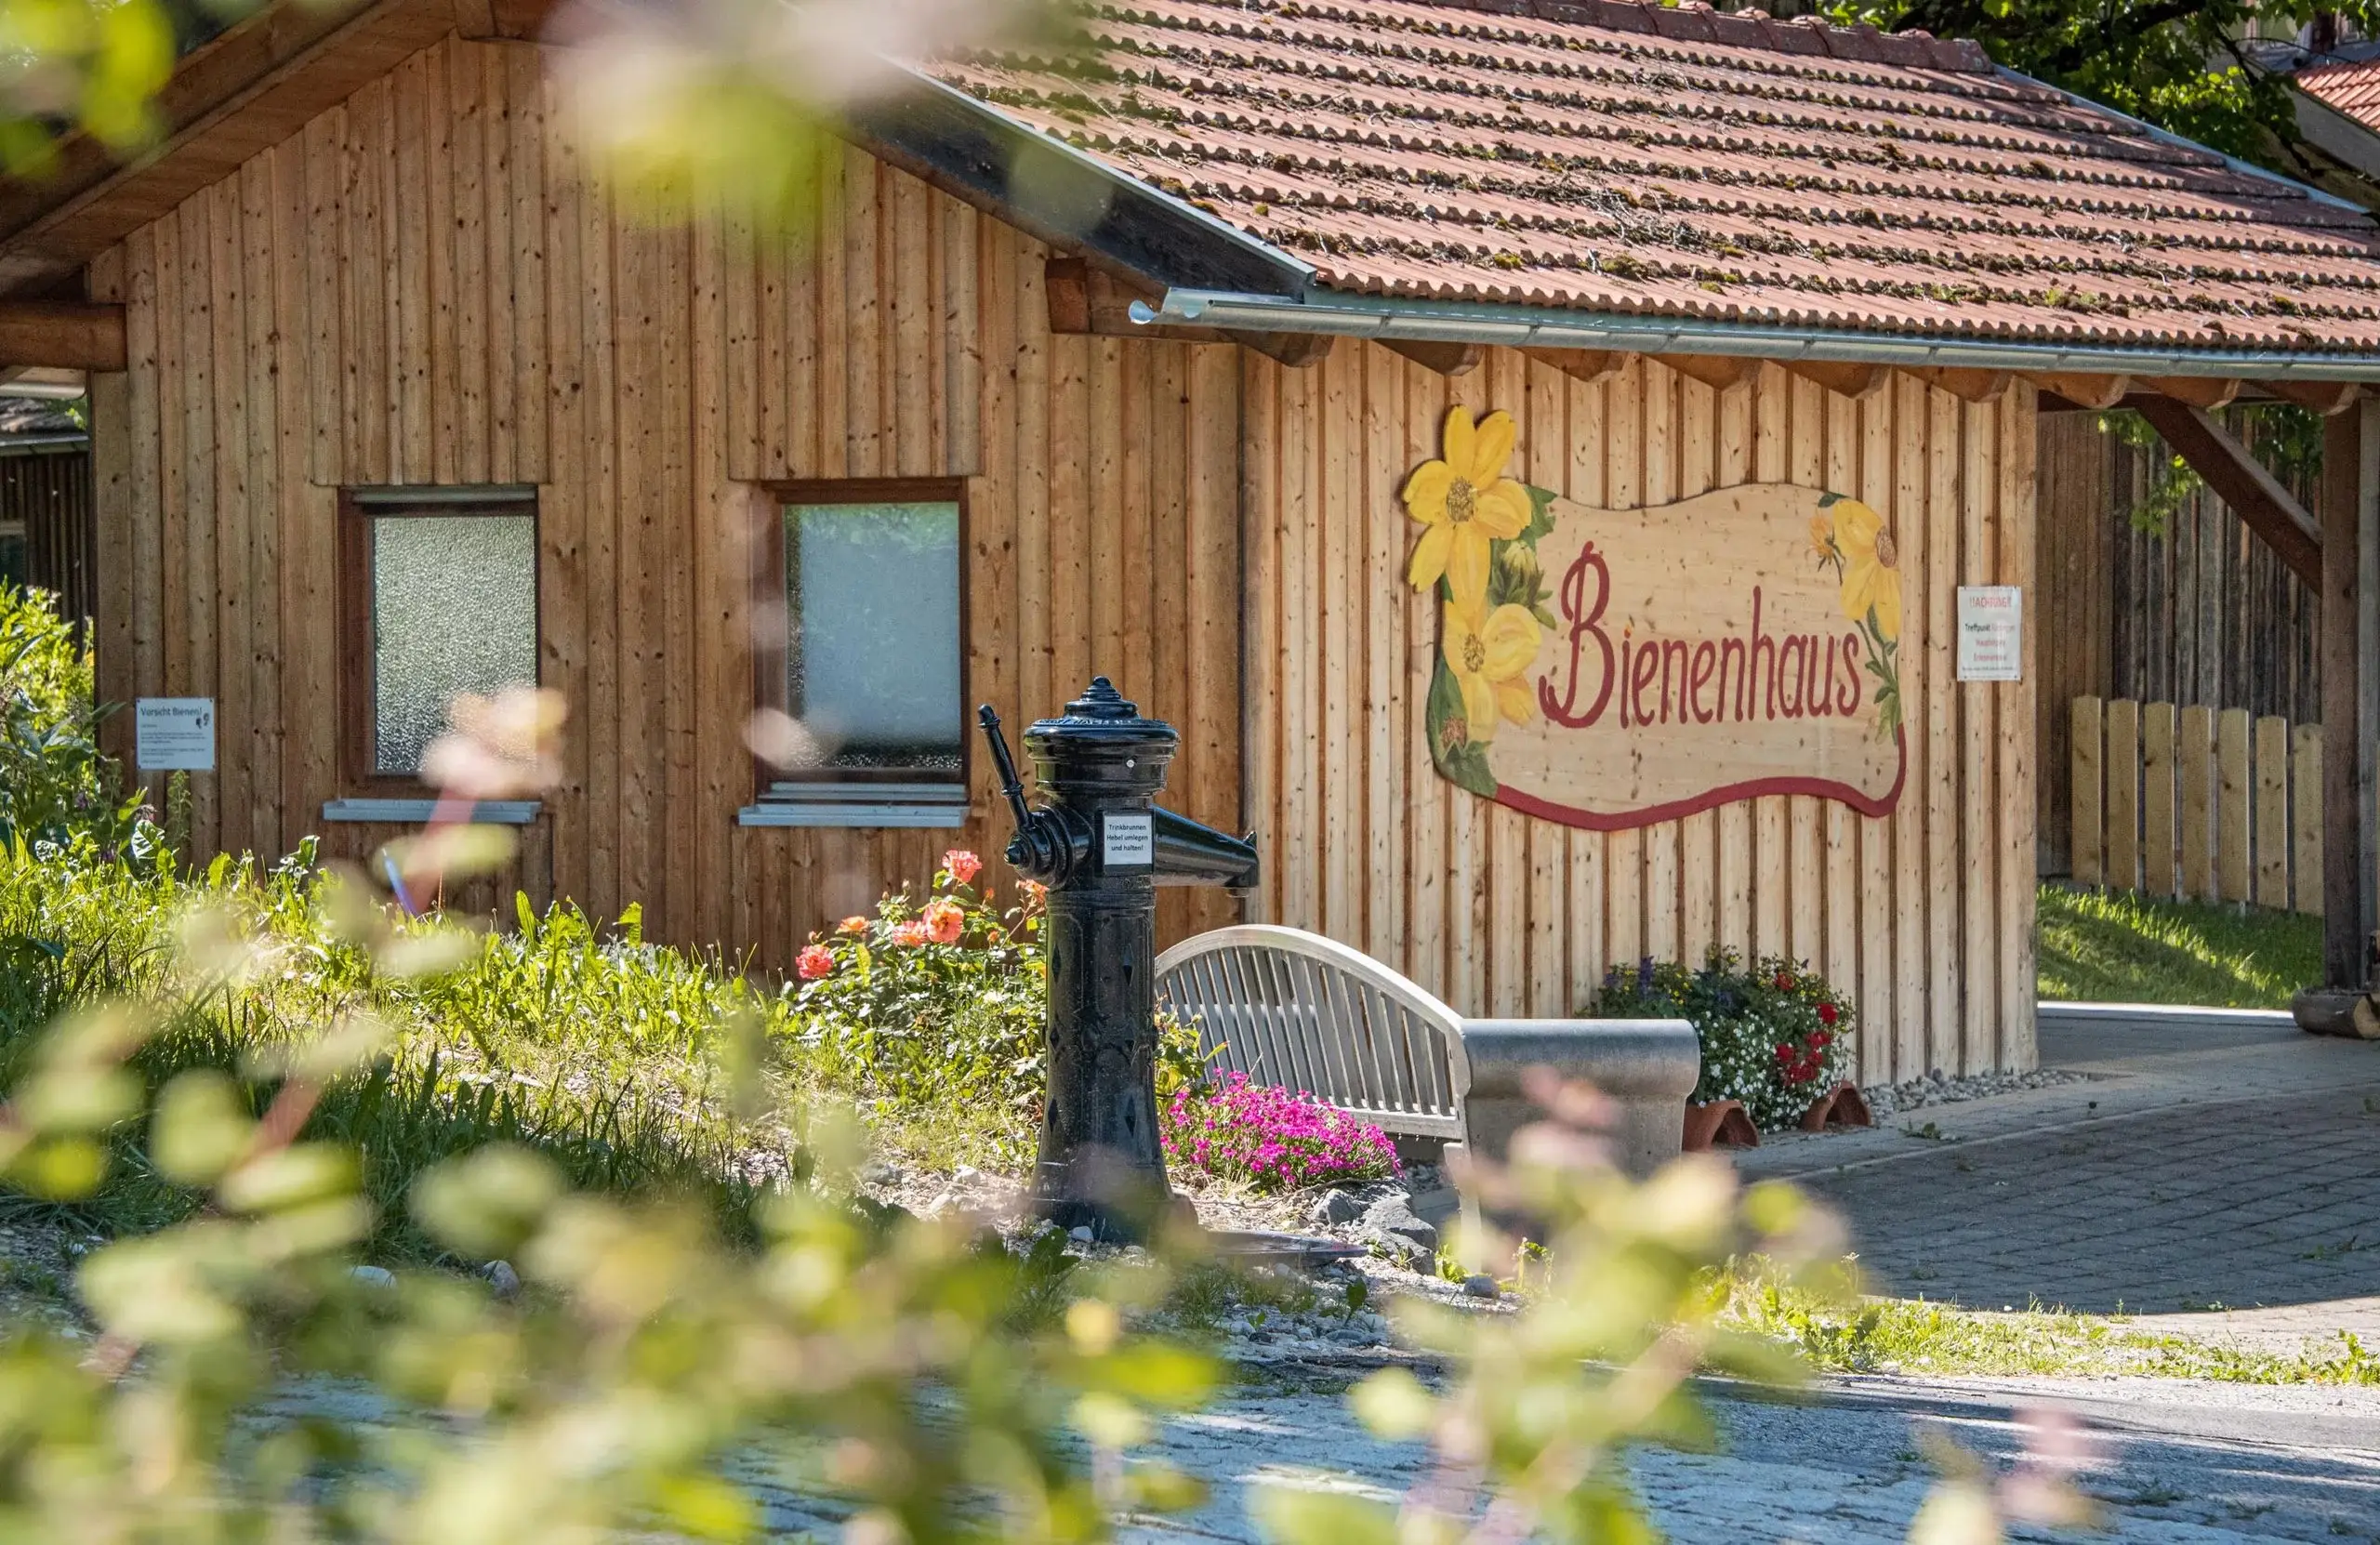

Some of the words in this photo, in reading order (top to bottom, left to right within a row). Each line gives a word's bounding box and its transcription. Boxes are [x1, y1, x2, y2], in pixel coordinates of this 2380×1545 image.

[1964, 622, 1990, 633] Treffpunkt
[1538, 540, 1861, 730] Bienenhaus
[140, 706, 171, 717] Vorsicht
[172, 706, 202, 717] Bienen!
[1124, 834, 1148, 842] umlegen
